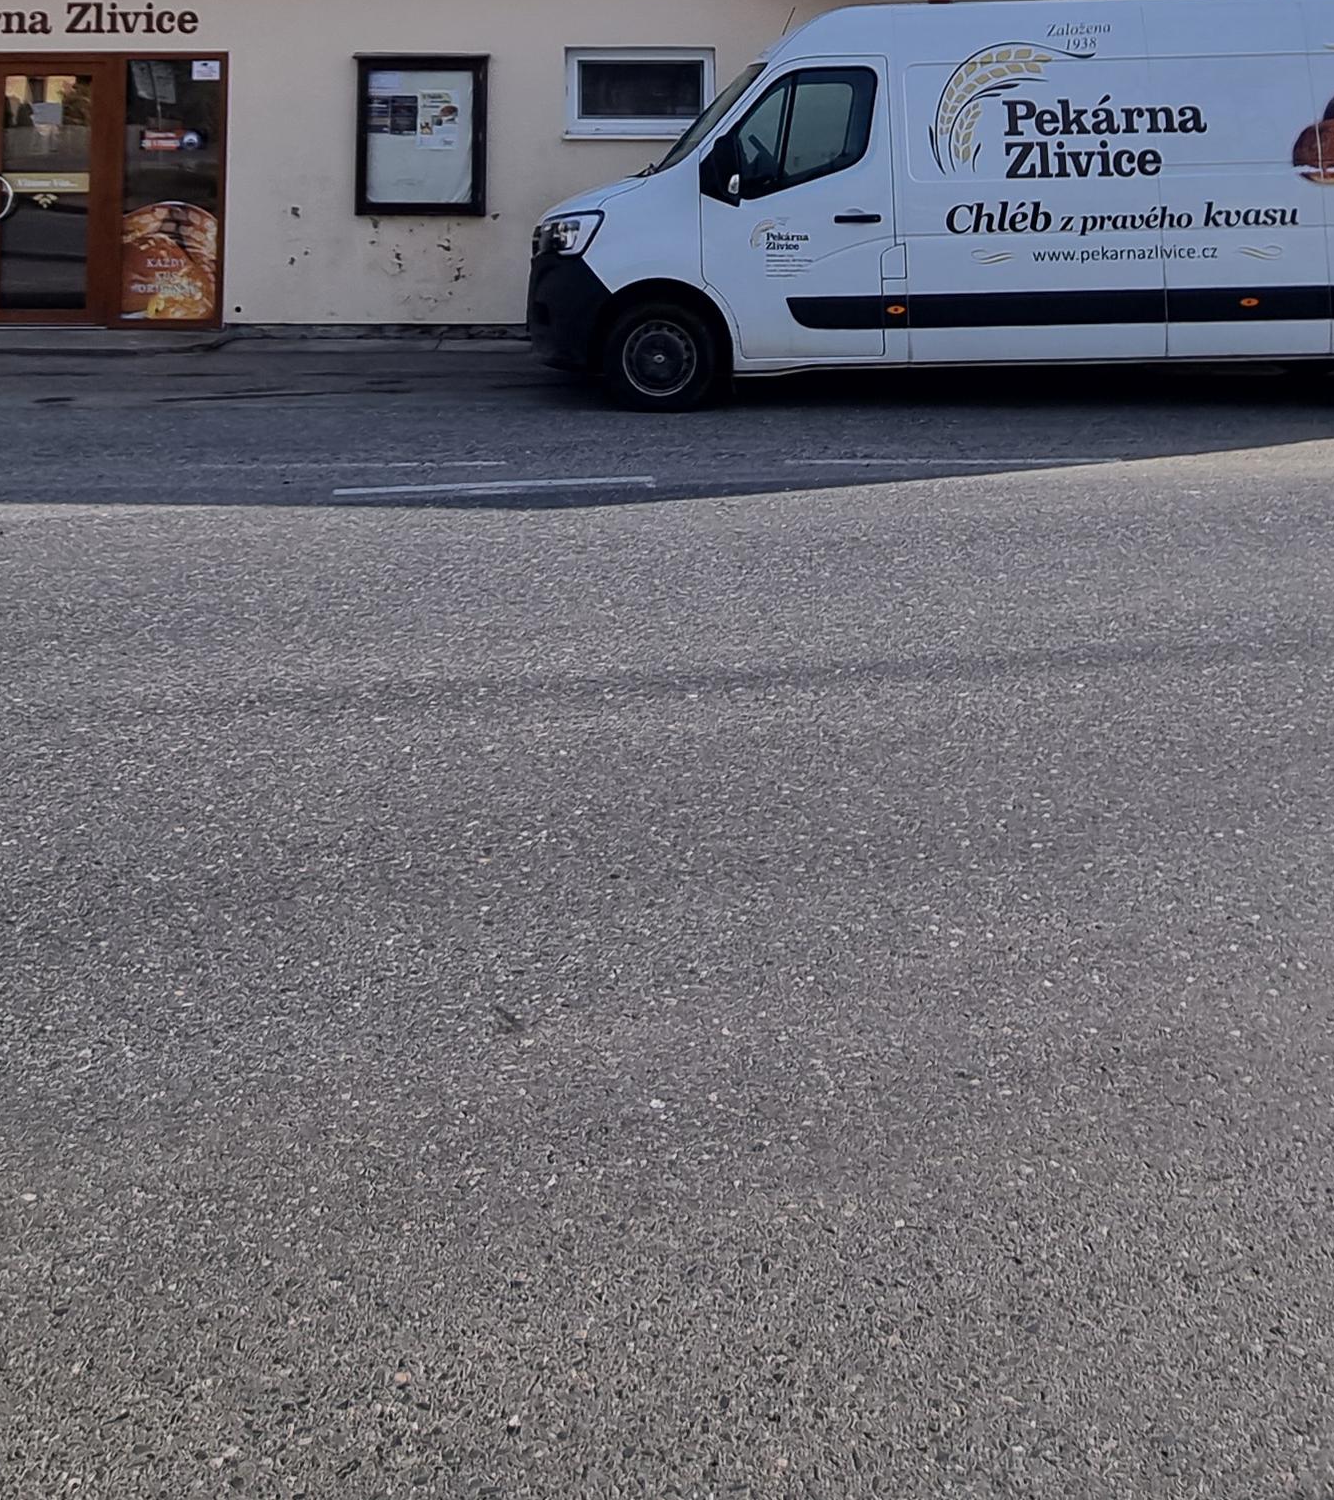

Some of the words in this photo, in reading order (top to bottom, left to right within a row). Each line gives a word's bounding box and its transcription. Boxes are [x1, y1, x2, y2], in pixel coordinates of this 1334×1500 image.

[65, 2, 199, 34] Zlivice
[1047, 22, 1111, 37] Založena
[1066, 37, 1097, 50] 1938
[1002, 94, 1208, 136] Pekárna
[1004, 140, 1162, 179] Zlivice
[946, 200, 1053, 234] Chléb
[1059, 215, 1075, 231] z
[1079, 206, 1193, 236] pravého
[1203, 201, 1299, 227] kvasu
[1033, 244, 1218, 264] www.pekarnazlivice.cz
